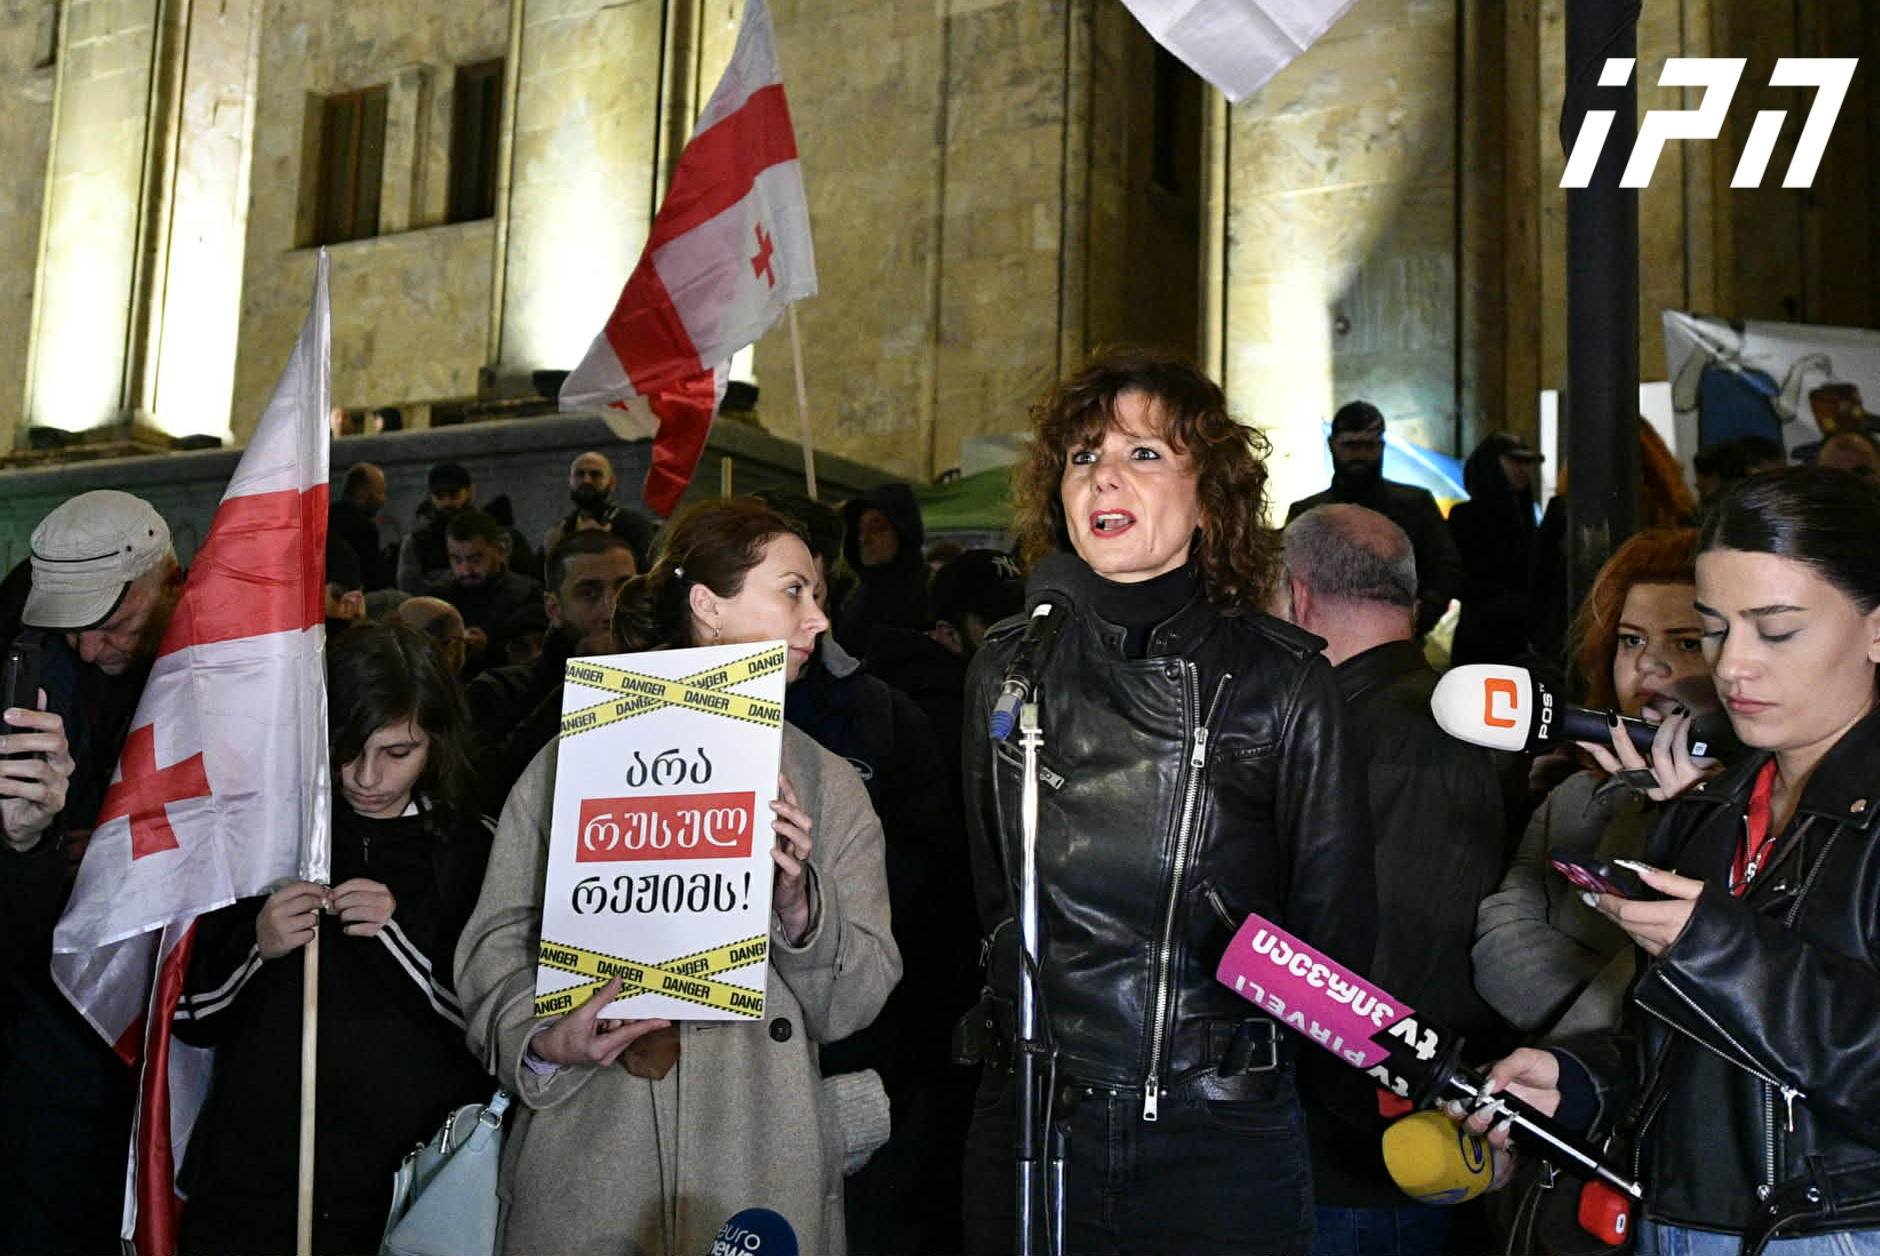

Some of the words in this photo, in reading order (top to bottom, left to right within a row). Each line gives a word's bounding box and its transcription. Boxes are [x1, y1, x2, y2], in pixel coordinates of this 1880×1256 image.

[621, 677, 666, 696] DANGER
[684, 690, 729, 711] DANGER
[626, 747, 712, 787] არა
[583, 807, 748, 851] რუსულ
[571, 871, 751, 914] რეჟიმს!
[597, 960, 643, 983] DANGER
[662, 975, 710, 999] DANGER
[1235, 975, 1367, 1067] PIRVELI
[1388, 1017, 1438, 1061] tv
